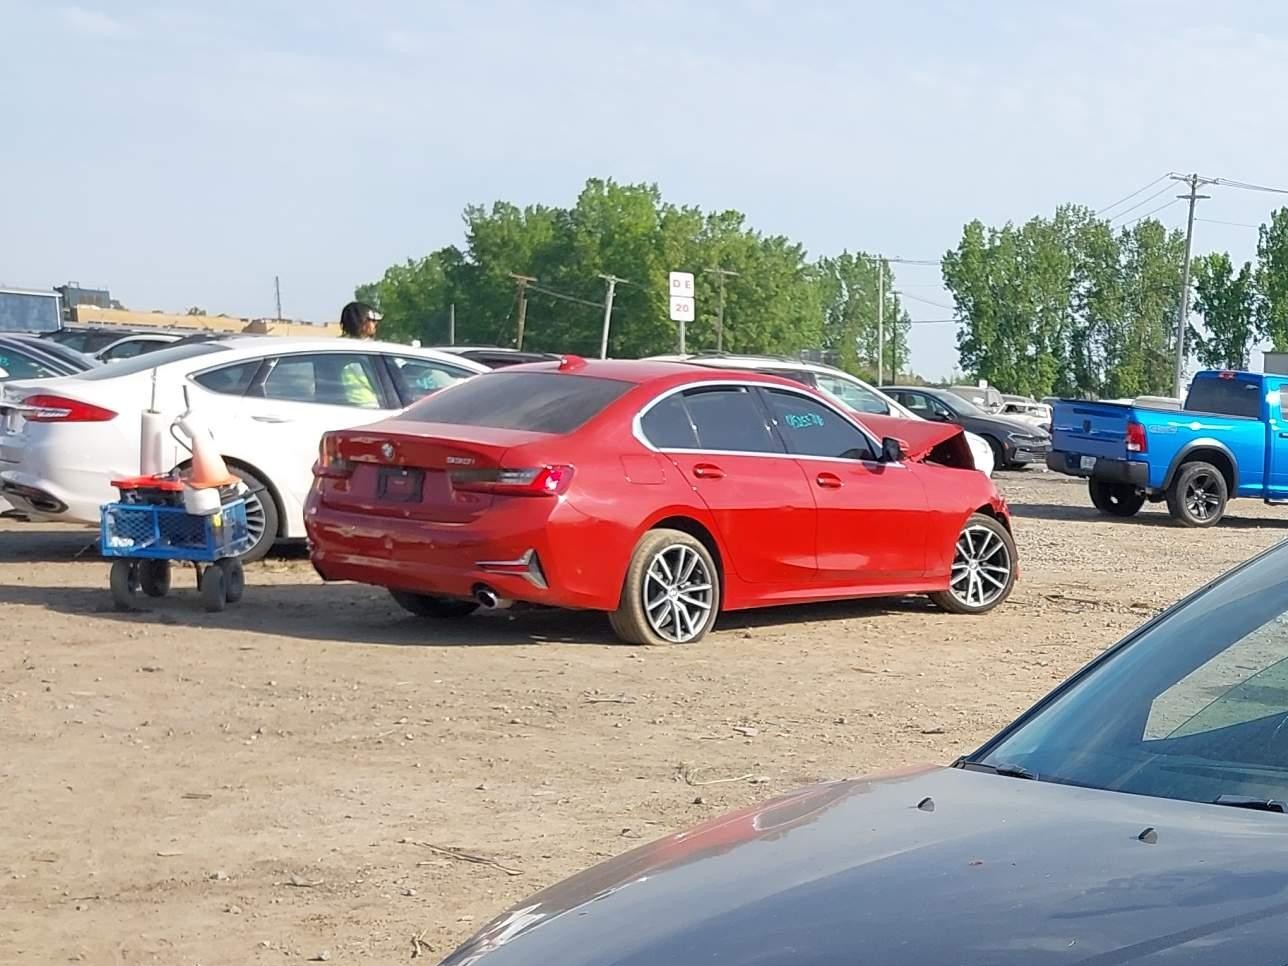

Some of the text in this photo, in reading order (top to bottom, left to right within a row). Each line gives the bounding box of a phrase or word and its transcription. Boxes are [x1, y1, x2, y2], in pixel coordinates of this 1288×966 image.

[672, 279, 691, 289] D E
[675, 304, 689, 312] 20
